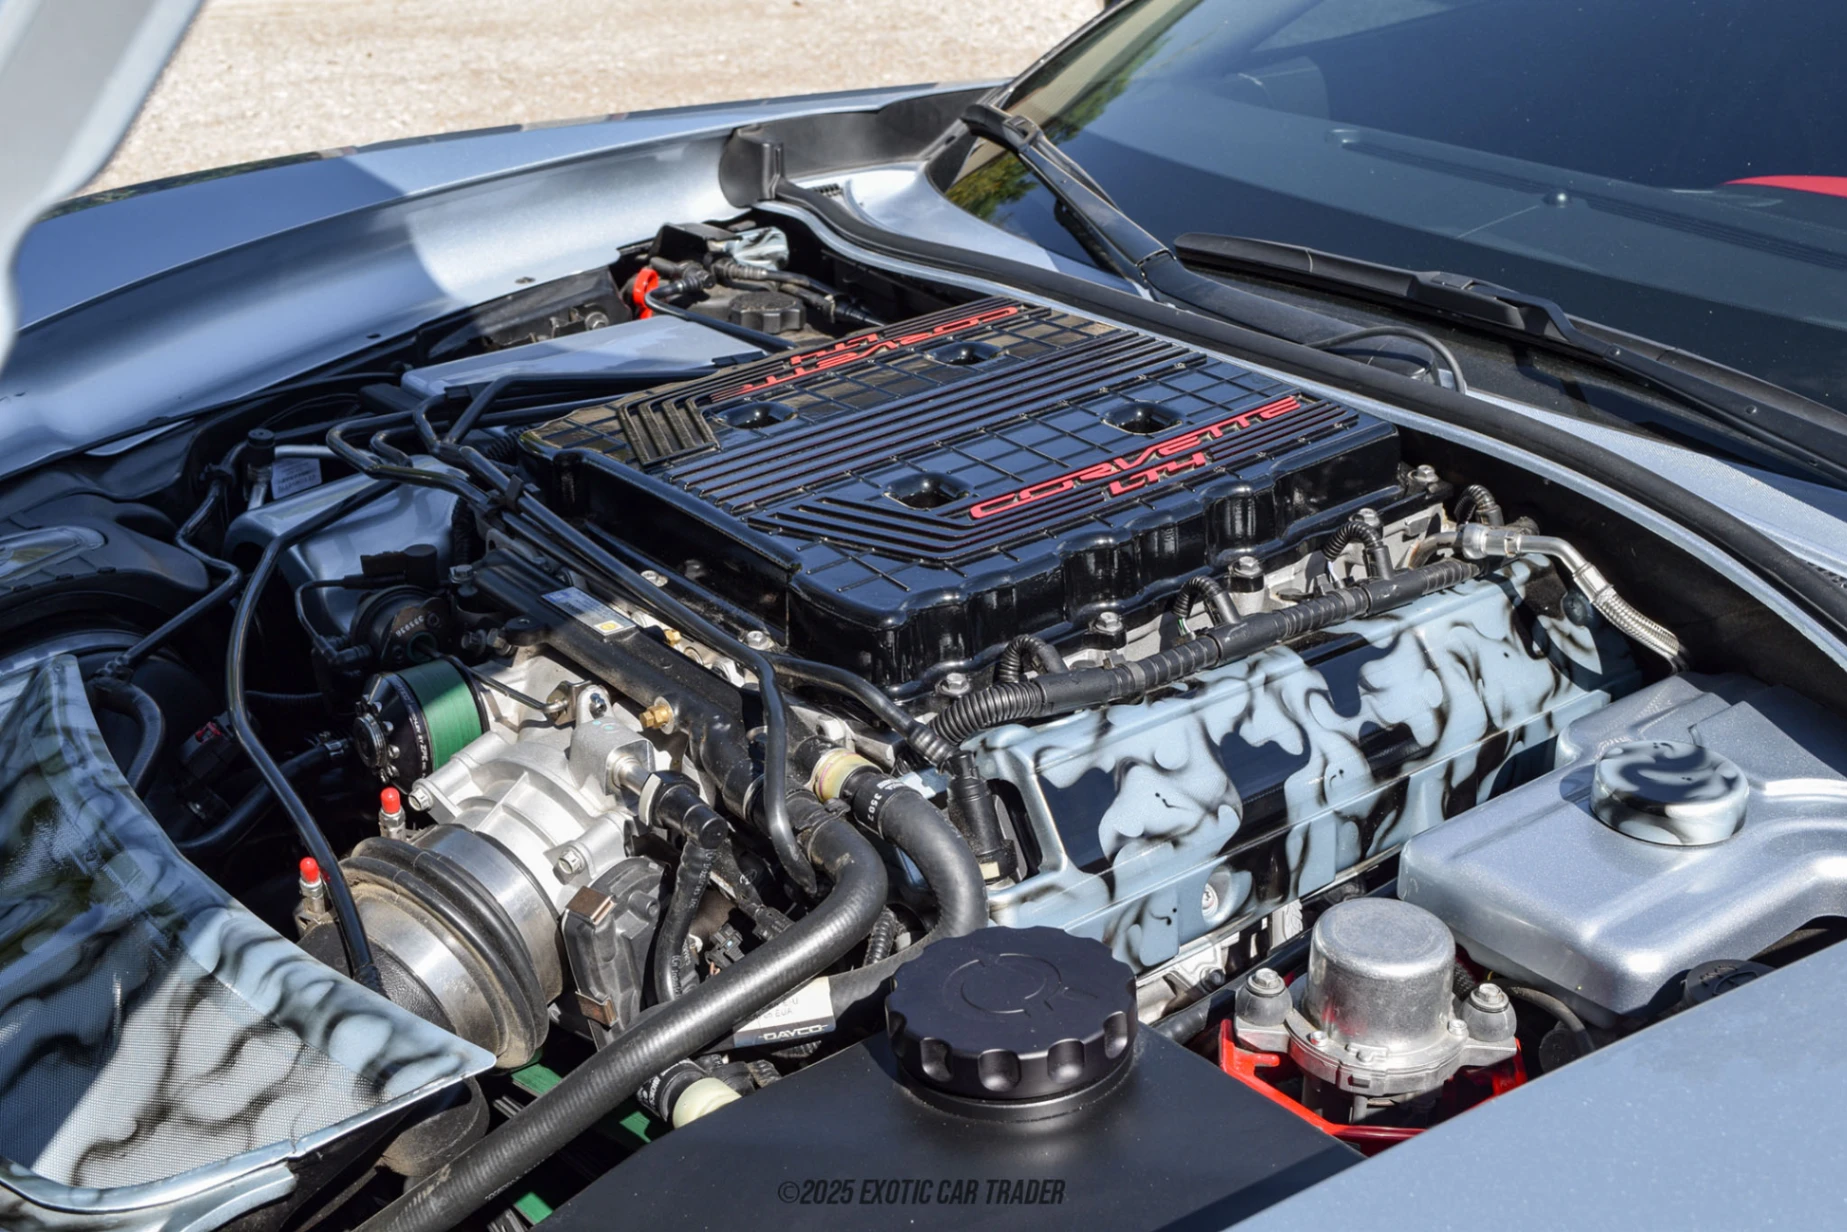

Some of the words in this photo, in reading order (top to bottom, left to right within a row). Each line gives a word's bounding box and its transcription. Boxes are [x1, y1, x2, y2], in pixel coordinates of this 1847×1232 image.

[970, 395, 1301, 520] CORVETTE
[1108, 451, 1208, 496] LT4
[762, 1025, 823, 1042] DAYCO
